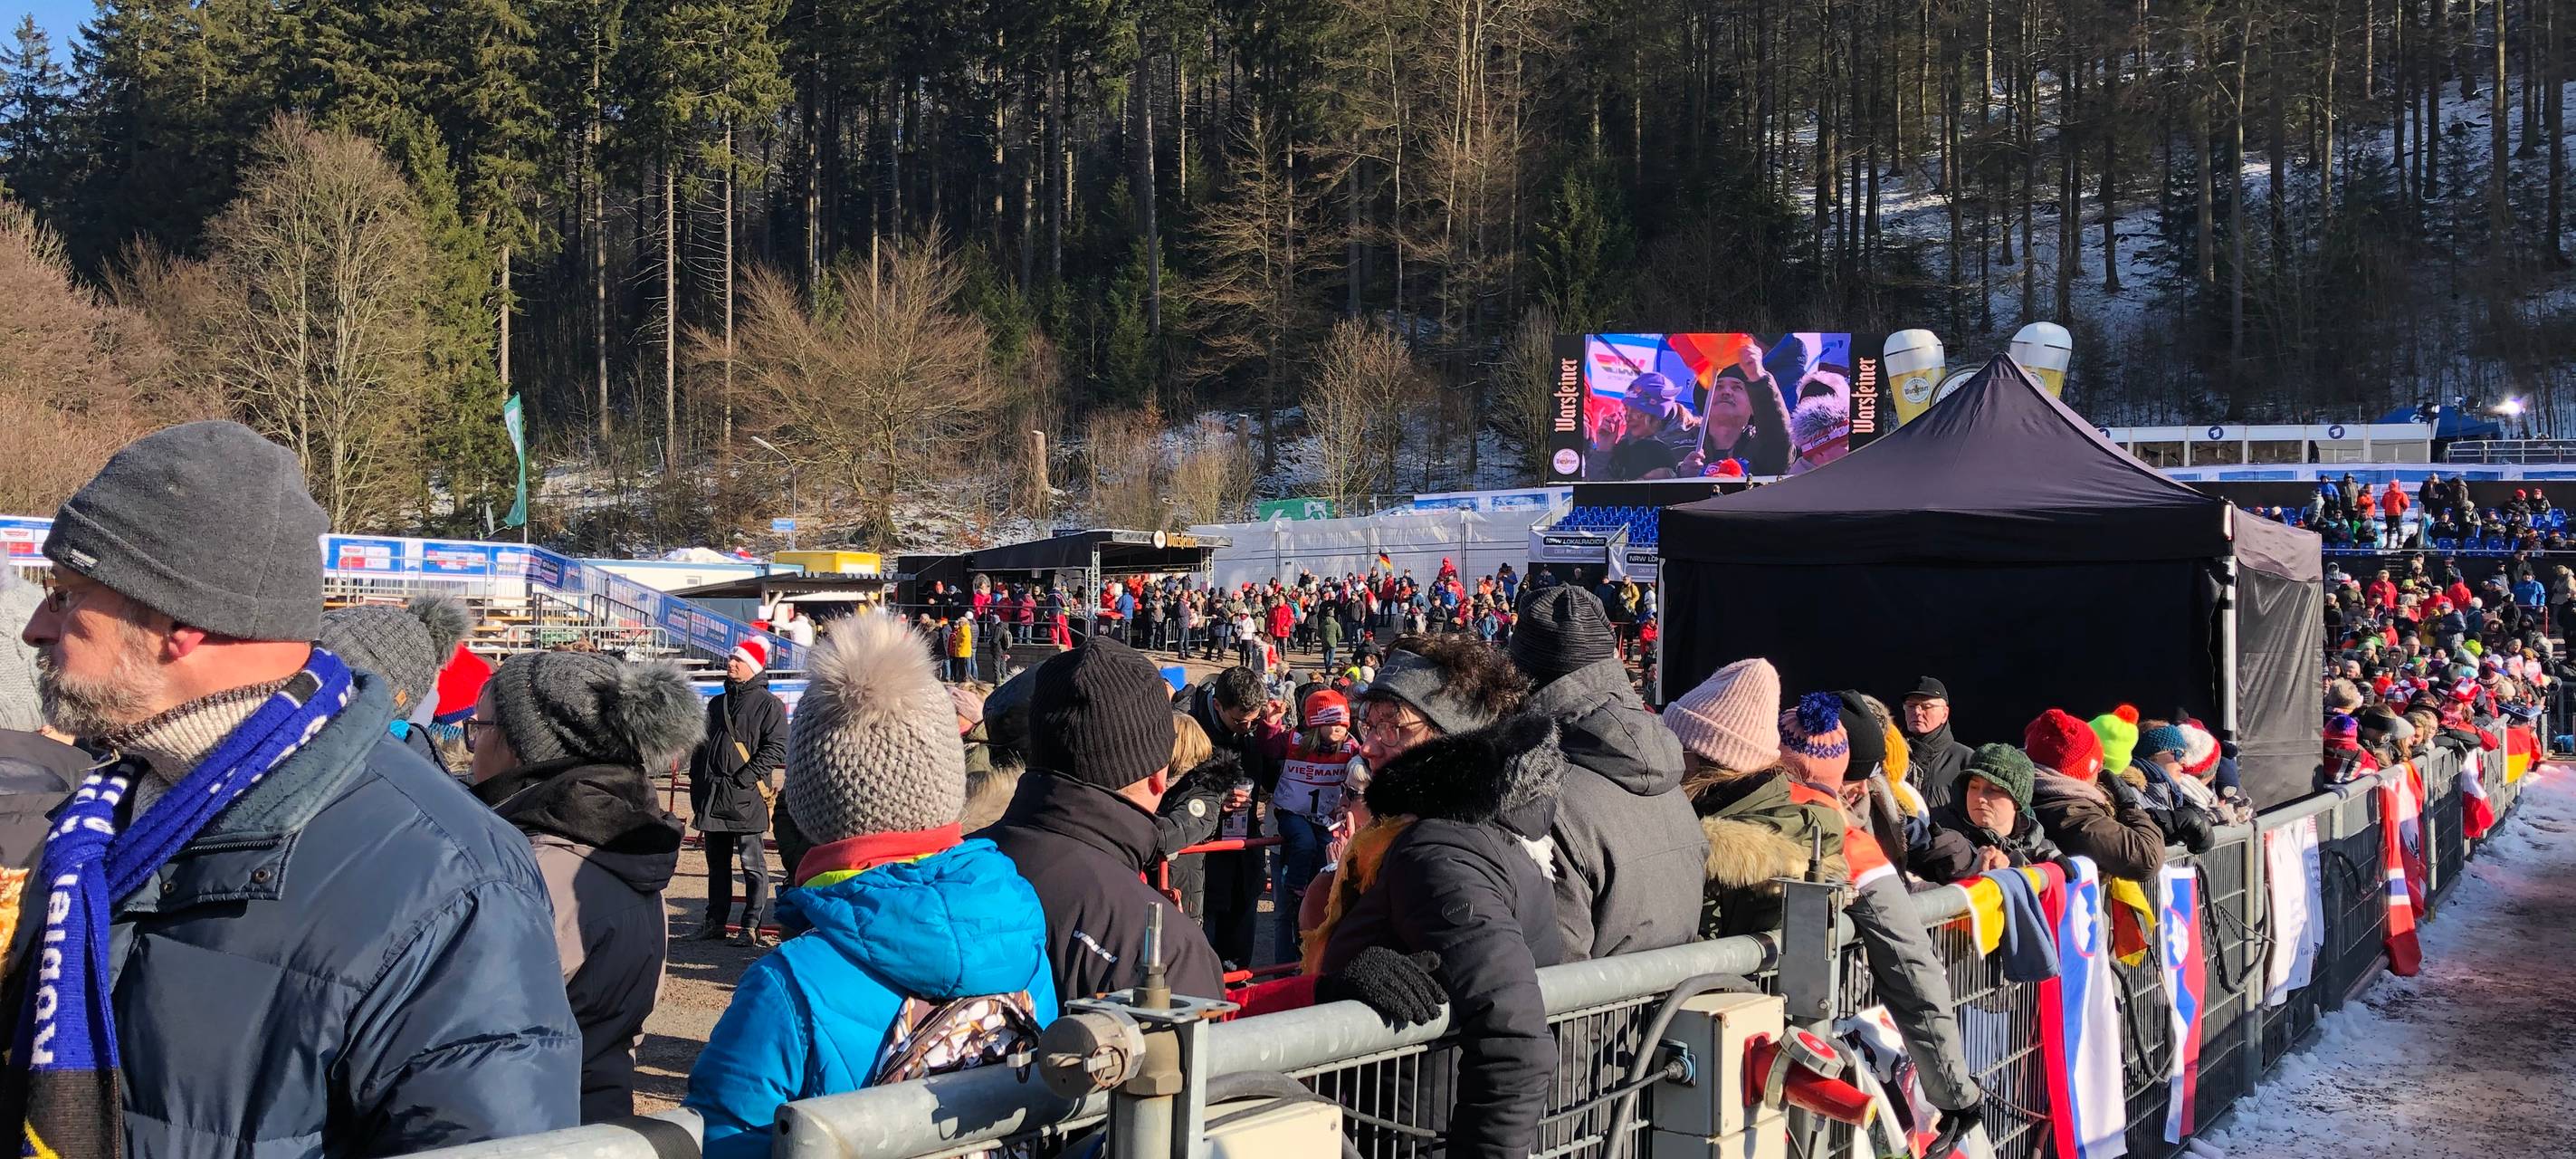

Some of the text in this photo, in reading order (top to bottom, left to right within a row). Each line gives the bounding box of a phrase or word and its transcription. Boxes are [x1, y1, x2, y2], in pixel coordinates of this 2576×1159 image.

[1553, 358, 1579, 432] Warsteiner
[1851, 357, 1878, 434] Warsteiner
[1308, 789, 1321, 814] 1
